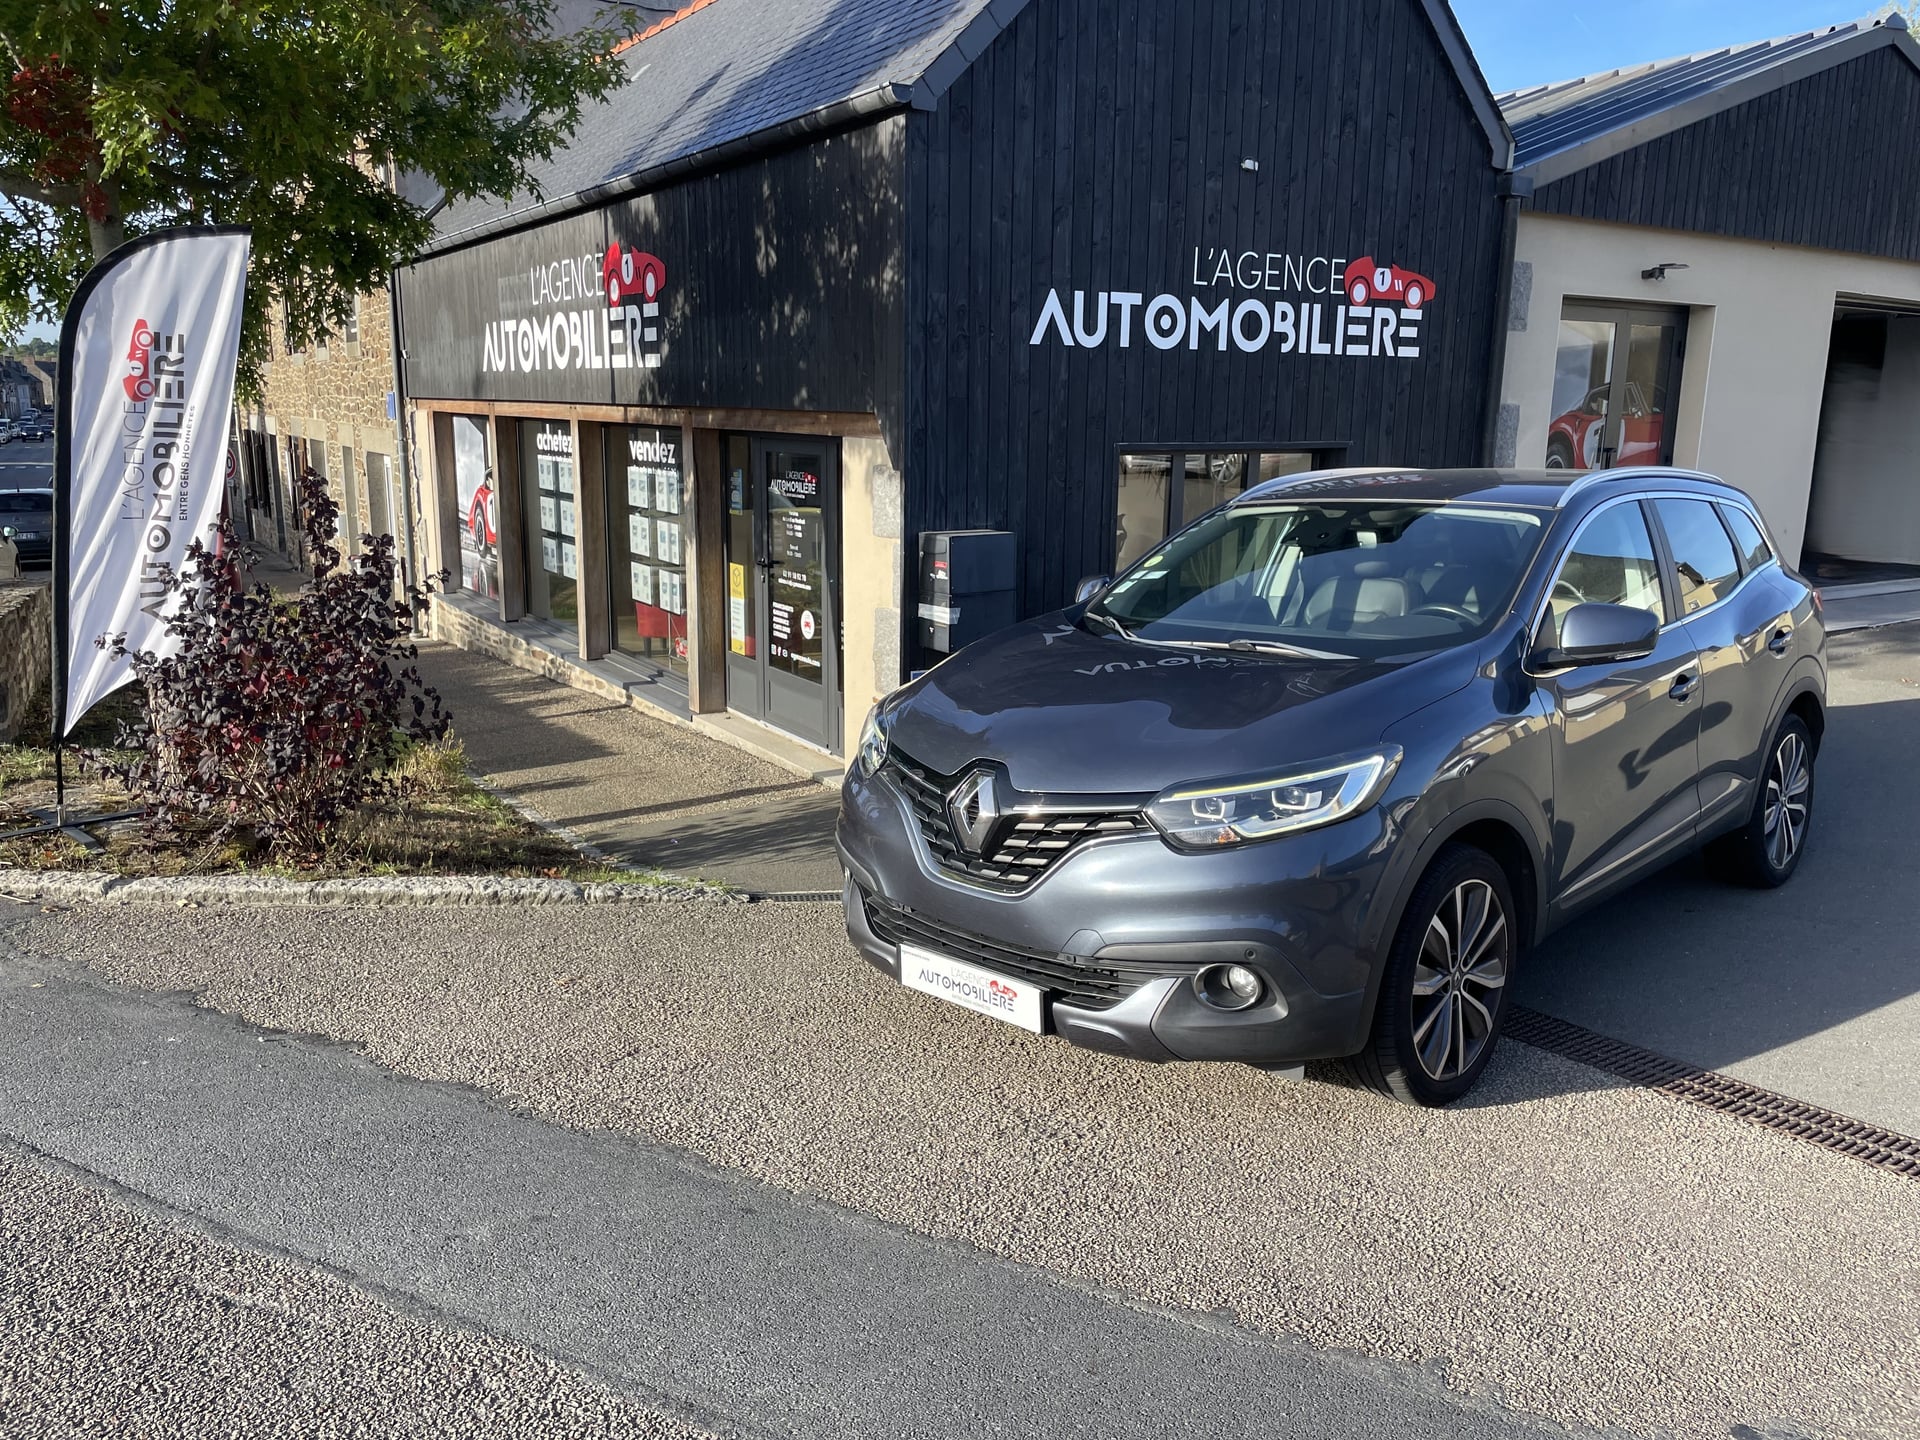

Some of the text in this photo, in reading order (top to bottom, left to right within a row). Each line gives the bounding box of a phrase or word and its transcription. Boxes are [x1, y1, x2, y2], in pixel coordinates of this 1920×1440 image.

[530, 253, 605, 305] L'AGENCE
[1193, 246, 1346, 294] L'AGENCE
[482, 302, 661, 373] AUTOMOBILIERE
[1029, 288, 1423, 358] AUTOMOBILIERE
[122, 401, 146, 520] L'AGENCE
[536, 424, 573, 453] achetez
[628, 430, 676, 464] vendez
[180, 461, 189, 488] GENS
[179, 490, 188, 520] ENTRE
[918, 968, 1015, 1012] AUTOMOBILIERE
